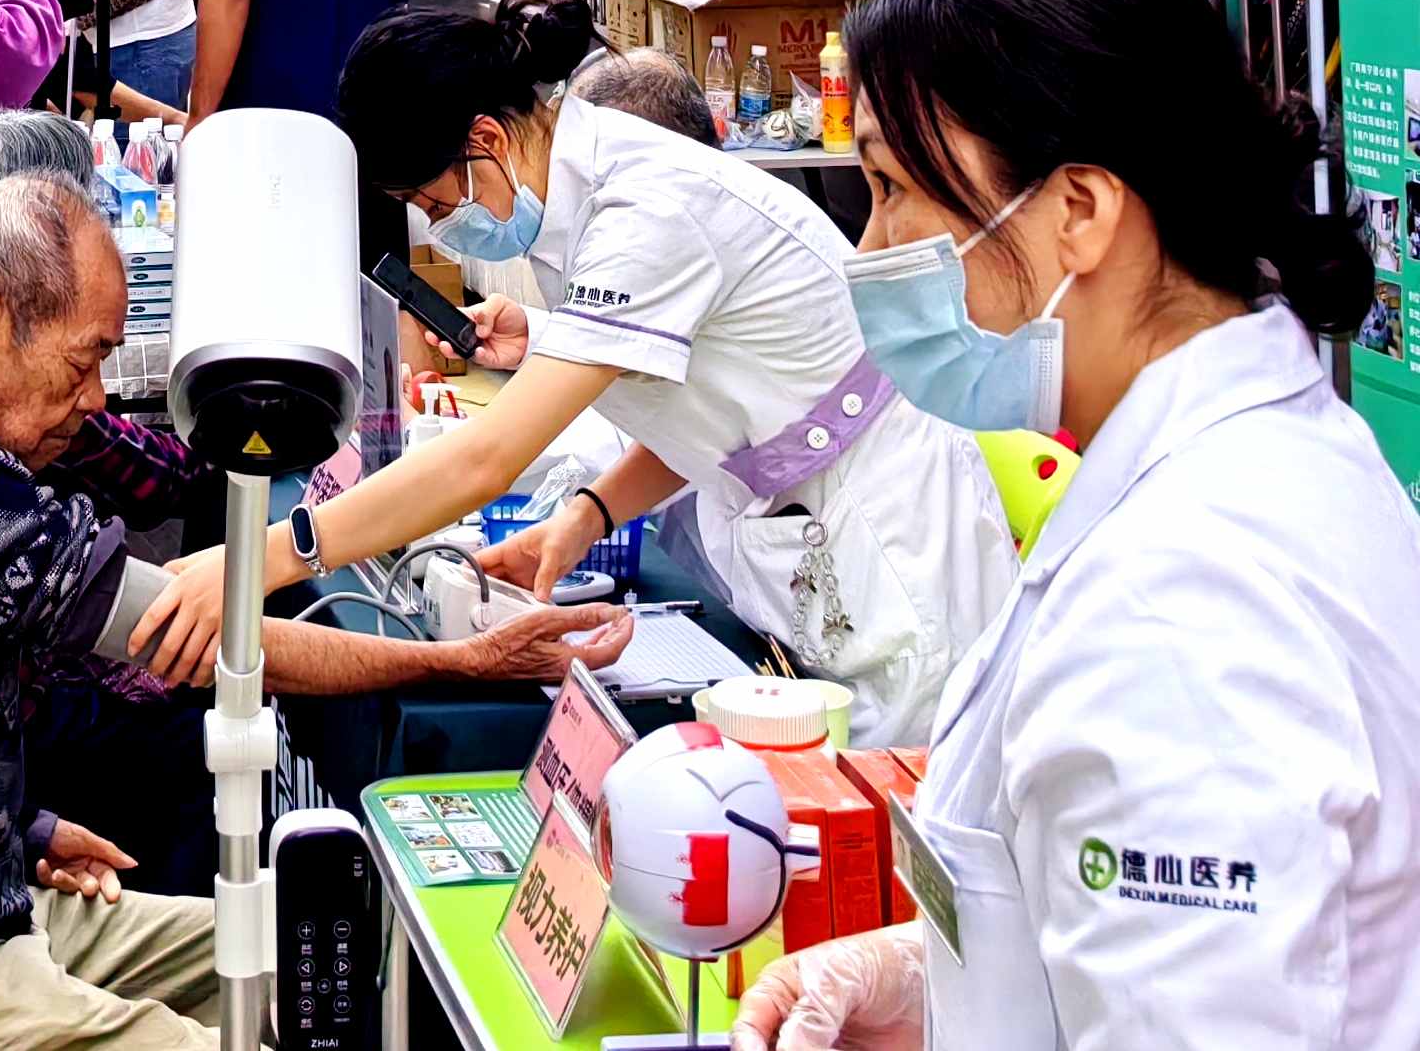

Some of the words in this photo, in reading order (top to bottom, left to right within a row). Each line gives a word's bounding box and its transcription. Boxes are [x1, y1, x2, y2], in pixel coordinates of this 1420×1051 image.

[1121, 849, 1257, 893] 德心医养
[516, 863, 586, 981] 视力养护
[311, 1038, 339, 1048] ZHIAI
